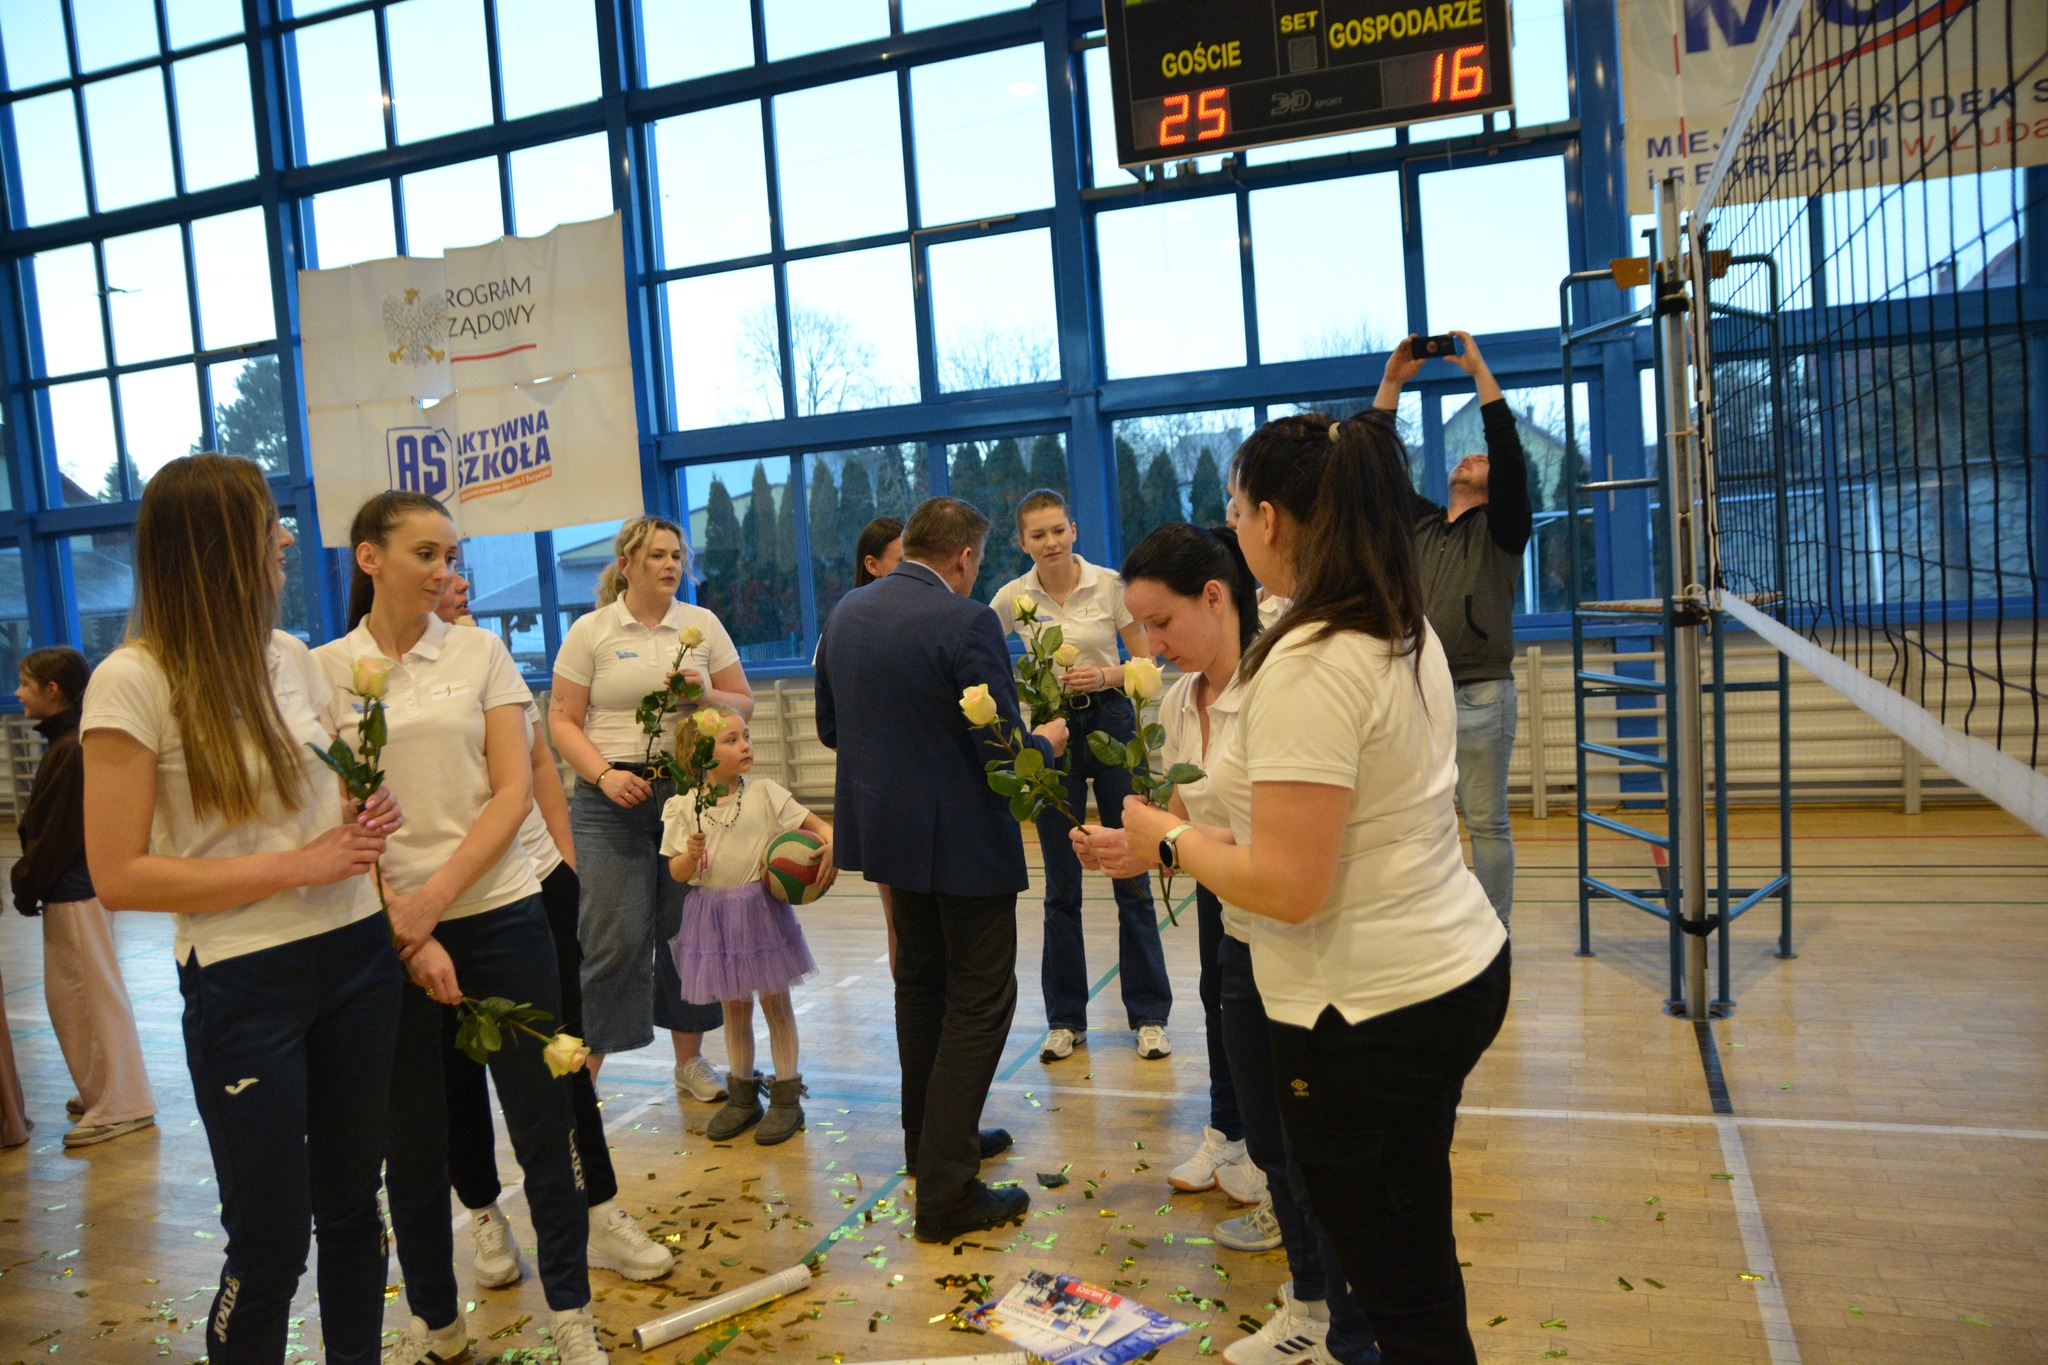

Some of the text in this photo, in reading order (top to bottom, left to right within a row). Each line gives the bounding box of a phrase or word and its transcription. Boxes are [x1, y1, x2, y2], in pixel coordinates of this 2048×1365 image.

[1280, 10, 1318, 33] SET
[1328, 1, 1482, 50] GOSPODARZE
[1162, 41, 1242, 78] GOŚCIE
[1432, 44, 1485, 103] 16
[1159, 87, 1226, 146] 25
[396, 435, 447, 497] AS
[1075, 1285, 1105, 1299] MIEJSCE
